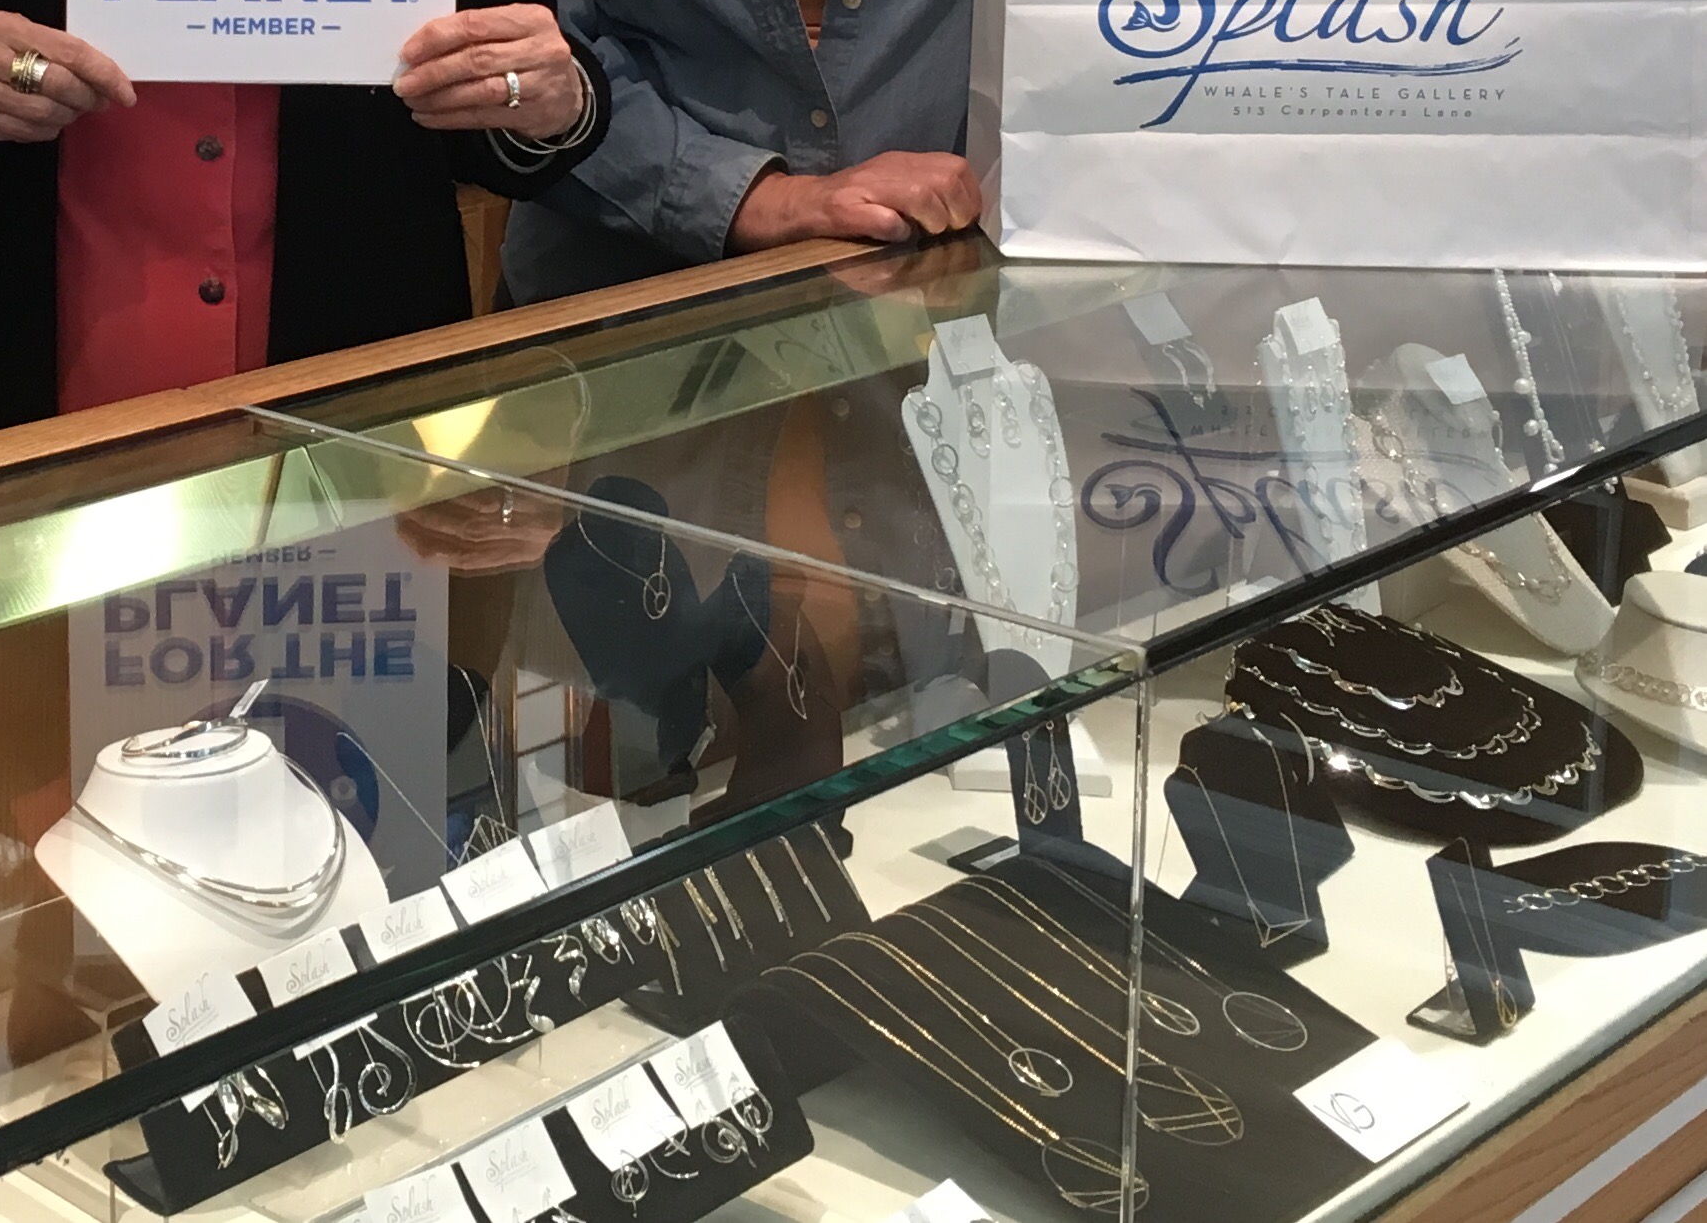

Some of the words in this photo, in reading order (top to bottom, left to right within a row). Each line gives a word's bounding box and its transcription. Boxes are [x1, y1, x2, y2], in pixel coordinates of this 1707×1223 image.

[212, 17, 315, 35] MEMBER
[1204, 87, 1309, 99] WHALE'S
[1326, 87, 1380, 99] TALE
[1398, 88, 1506, 101] GALLERY
[1233, 106, 1265, 116] 513
[1281, 105, 1407, 118] Carpenters
[1423, 107, 1473, 118] Lane
